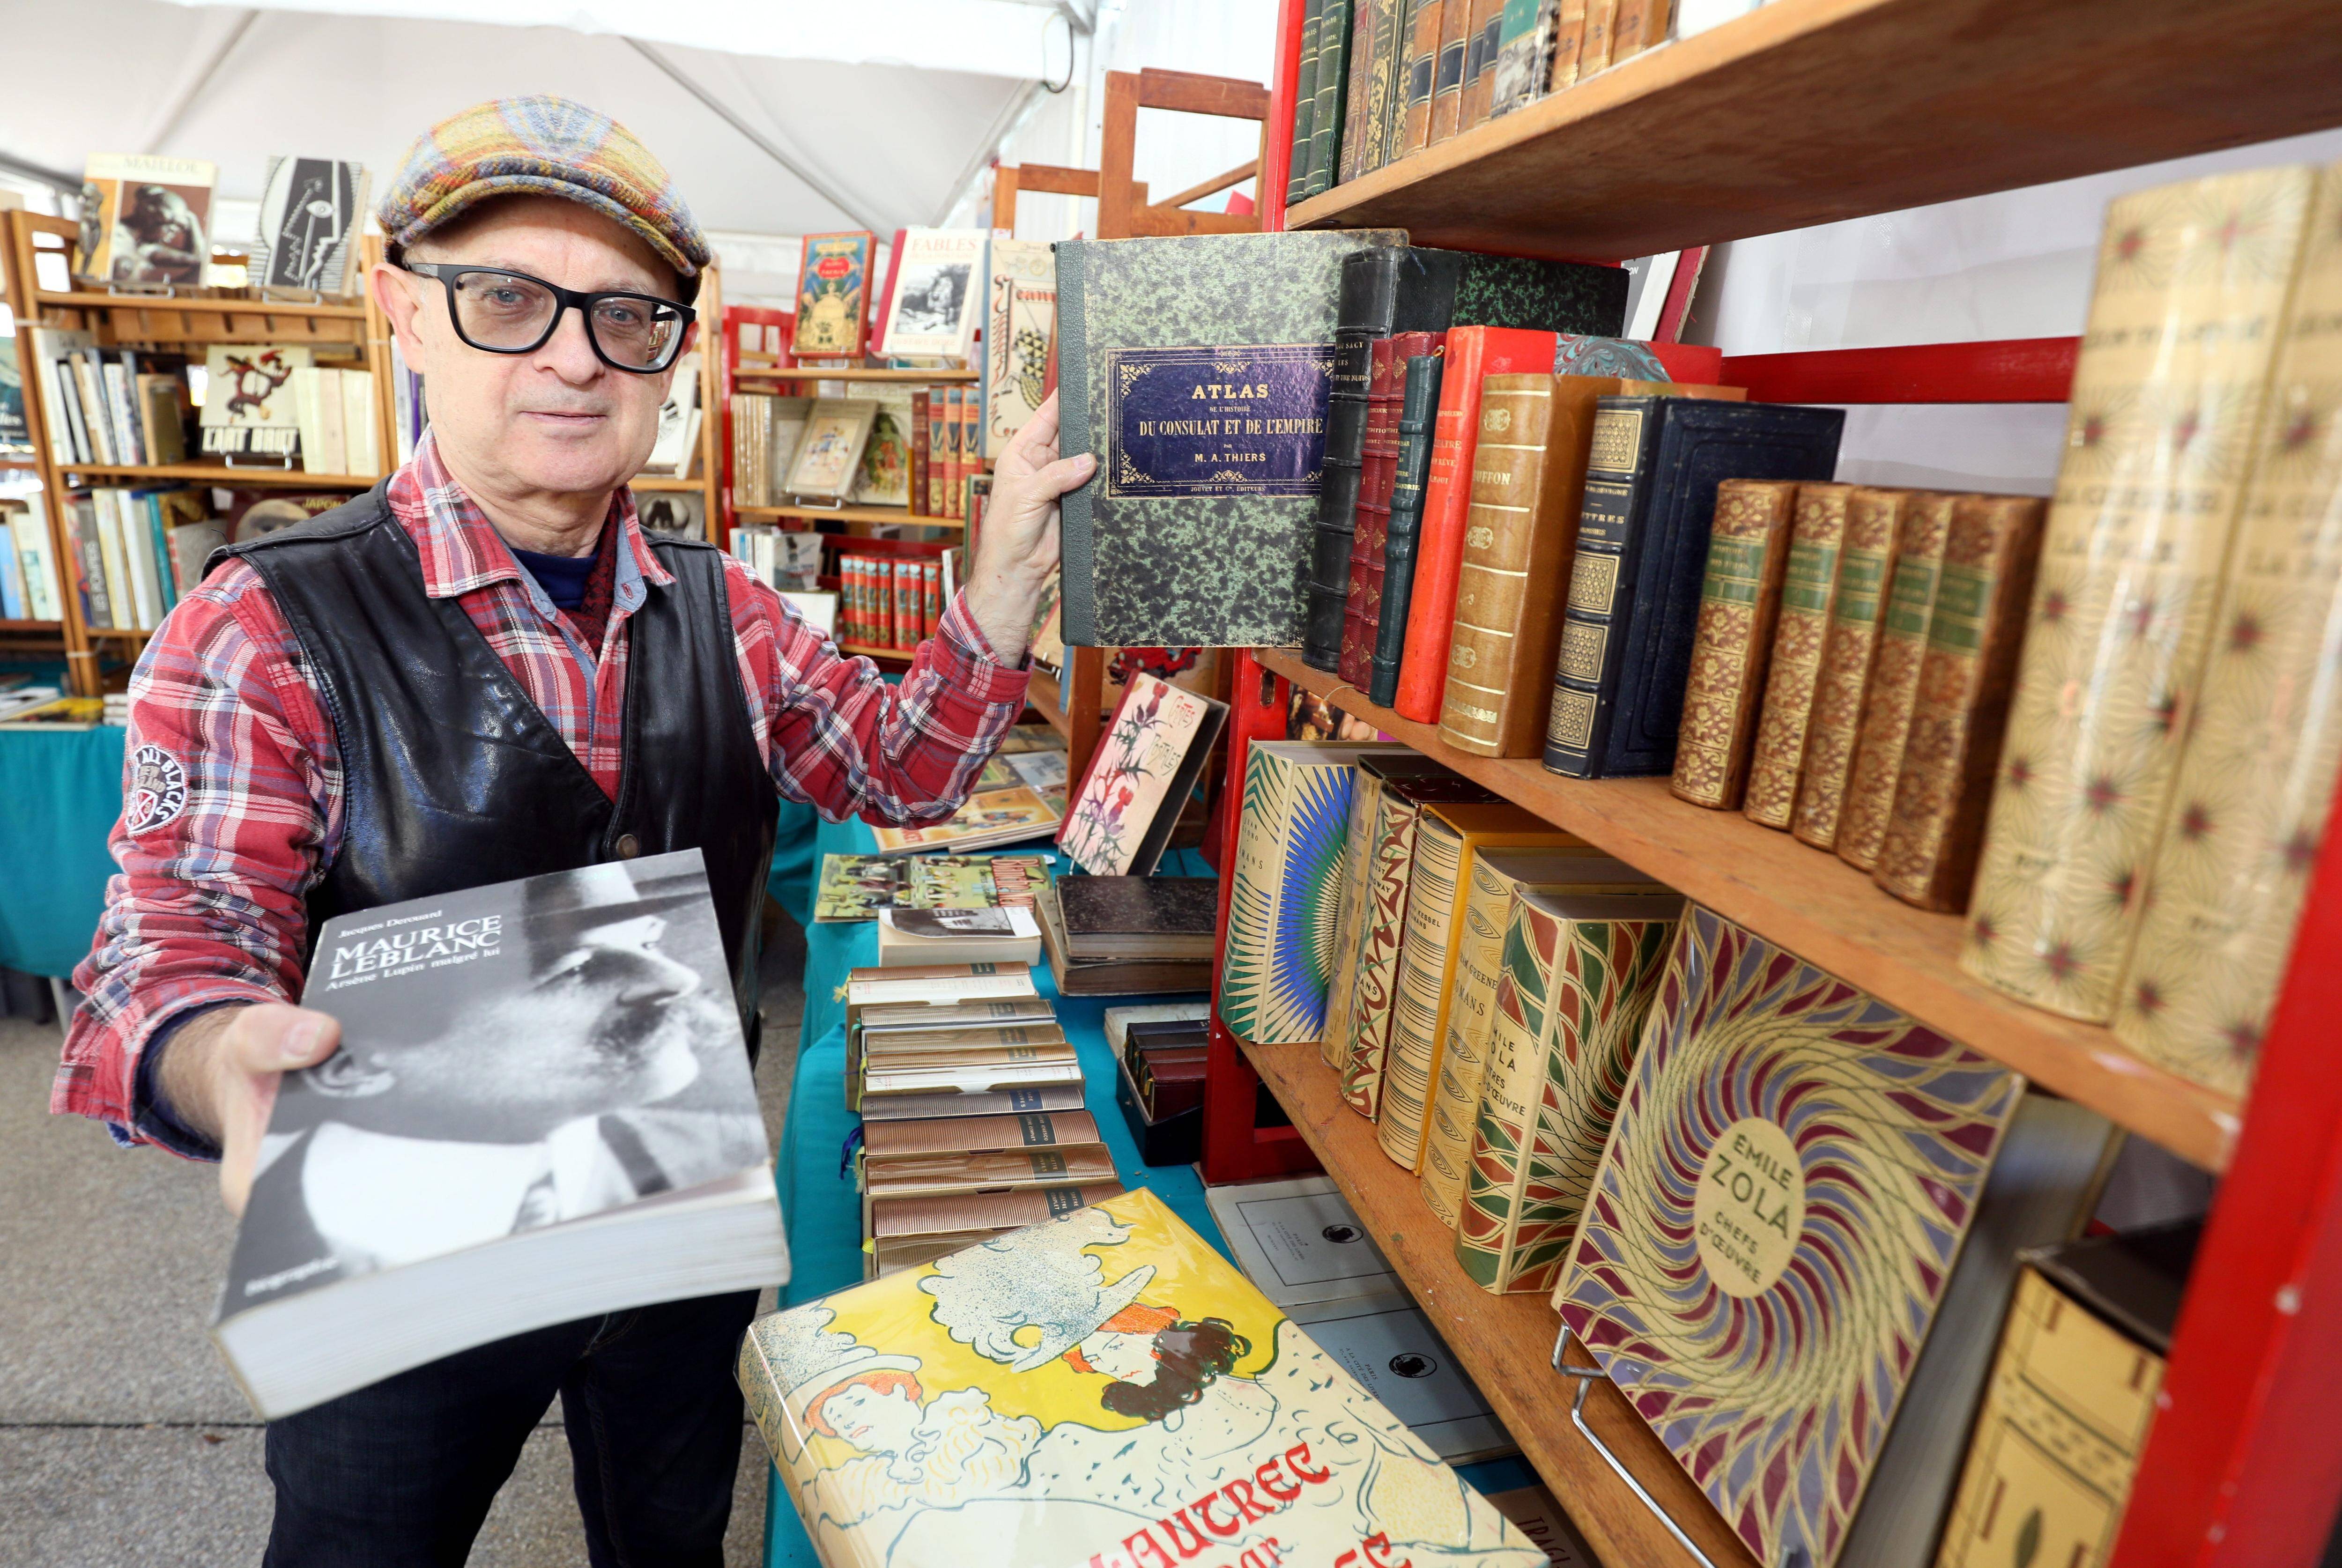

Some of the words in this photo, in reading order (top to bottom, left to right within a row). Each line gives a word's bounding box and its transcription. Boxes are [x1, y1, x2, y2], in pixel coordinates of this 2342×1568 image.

[912, 237, 977, 251] FABLES
[1191, 384, 1269, 399] ATLAS
[250, 427, 298, 453] BRUT
[1139, 421, 1156, 436] DU
[1159, 420, 1220, 436] CONSULAT
[1224, 420, 1239, 435] ET
[1246, 419, 1262, 435] DE
[1267, 418, 1324, 434] L'EMPIRE
[1211, 454, 1222, 462] A.
[1224, 453, 1267, 462] THIERS
[142, 748, 161, 765] ALL
[155, 759, 185, 821] BLACKS
[1244, 817, 1258, 830] JEAN
[1353, 830, 1367, 842] IONO
[338, 921, 385, 939] Jacques
[386, 910, 443, 928] Derouard
[1417, 910, 1441, 928] KESSEL
[333, 914, 503, 963] MAURICE
[328, 930, 502, 980] LEBLANC
[325, 972, 378, 991] Arsène
[383, 962, 426, 978] Lupin
[430, 951, 479, 968] malgré
[482, 947, 501, 958] lui
[1469, 964, 1497, 990] GREENE
[1359, 977, 1378, 995] ANS
[1493, 1027, 1515, 1052] MILE
[1490, 1041, 1517, 1073] OLA
[1485, 1062, 1505, 1089] UTRES
[1482, 1076, 1527, 1117] -D'ŒUVRE
[1070, 1191, 1079, 1207] SARTRE
[1711, 1153, 1789, 1240] ZOLA
[1715, 1211, 1758, 1255] CHEFS
[1699, 1221, 1762, 1285] D'ŒUVRE
[1364, 1363, 1378, 1380] PARIS
[1361, 1373, 1370, 1382] DES
[1367, 1383, 1381, 1399] LIVRES
